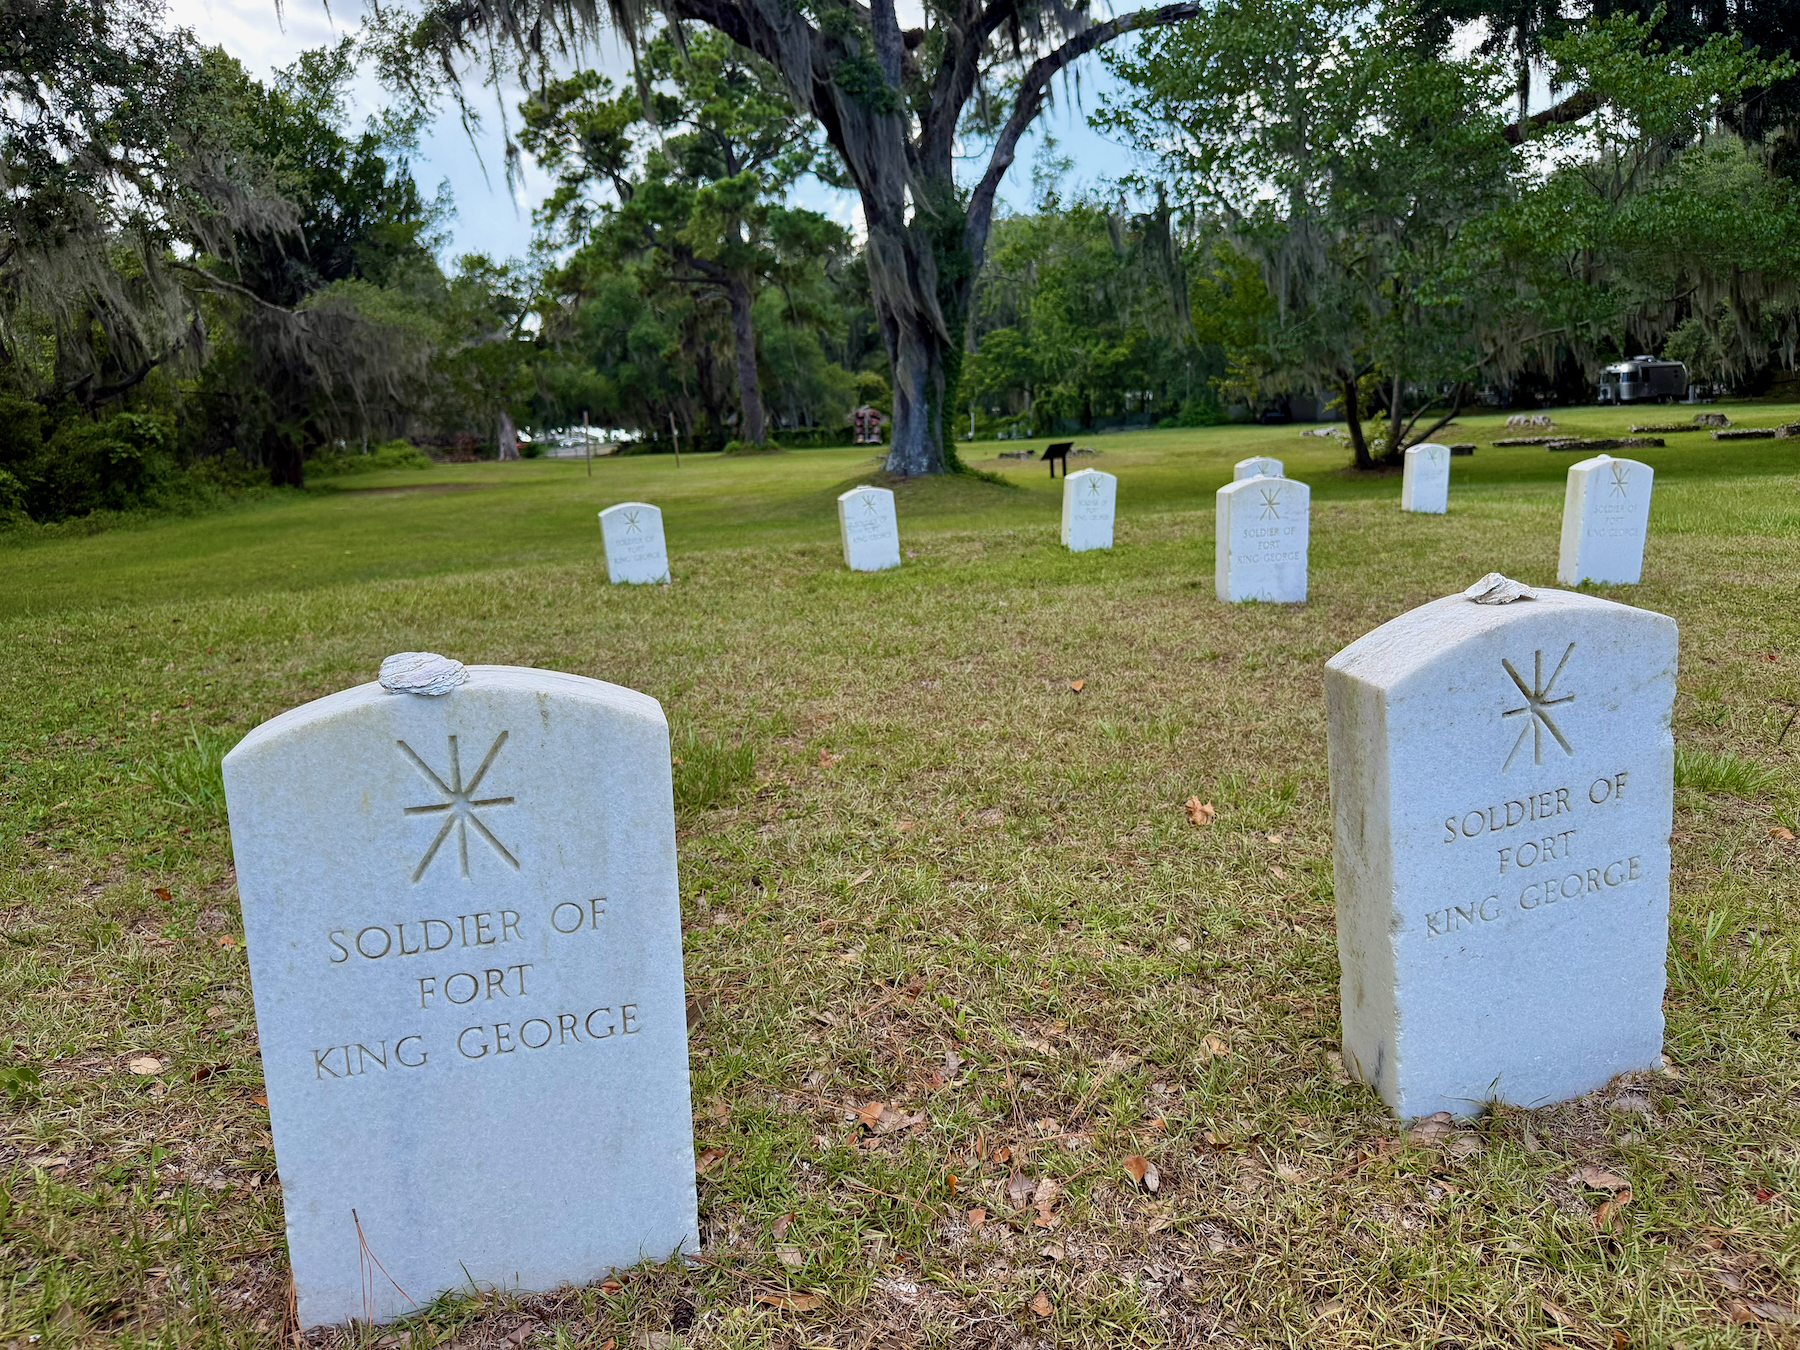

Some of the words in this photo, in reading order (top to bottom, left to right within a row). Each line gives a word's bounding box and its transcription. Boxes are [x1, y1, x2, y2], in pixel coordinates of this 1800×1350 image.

[1593, 504, 1625, 514] SOLDIER
[1627, 504, 1639, 514] OF
[1243, 527, 1280, 539] SOLDIER
[1283, 526, 1296, 536] OF
[1258, 540, 1280, 551] FORT
[1608, 527, 1639, 537] GEORGE
[1236, 554, 1259, 565] KING
[1263, 551, 1300, 563] GEORGE
[1443, 787, 1571, 844] SOLDIER
[1588, 771, 1629, 805] OF
[1497, 829, 1577, 874] FORT
[1424, 894, 1502, 939] KING
[1519, 855, 1643, 911] GEORGE
[328, 908, 522, 965] SOLDIER
[551, 896, 609, 935] OF
[417, 963, 534, 1009] FORT
[311, 1035, 429, 1081] KING
[456, 1003, 642, 1061] GEORGE
